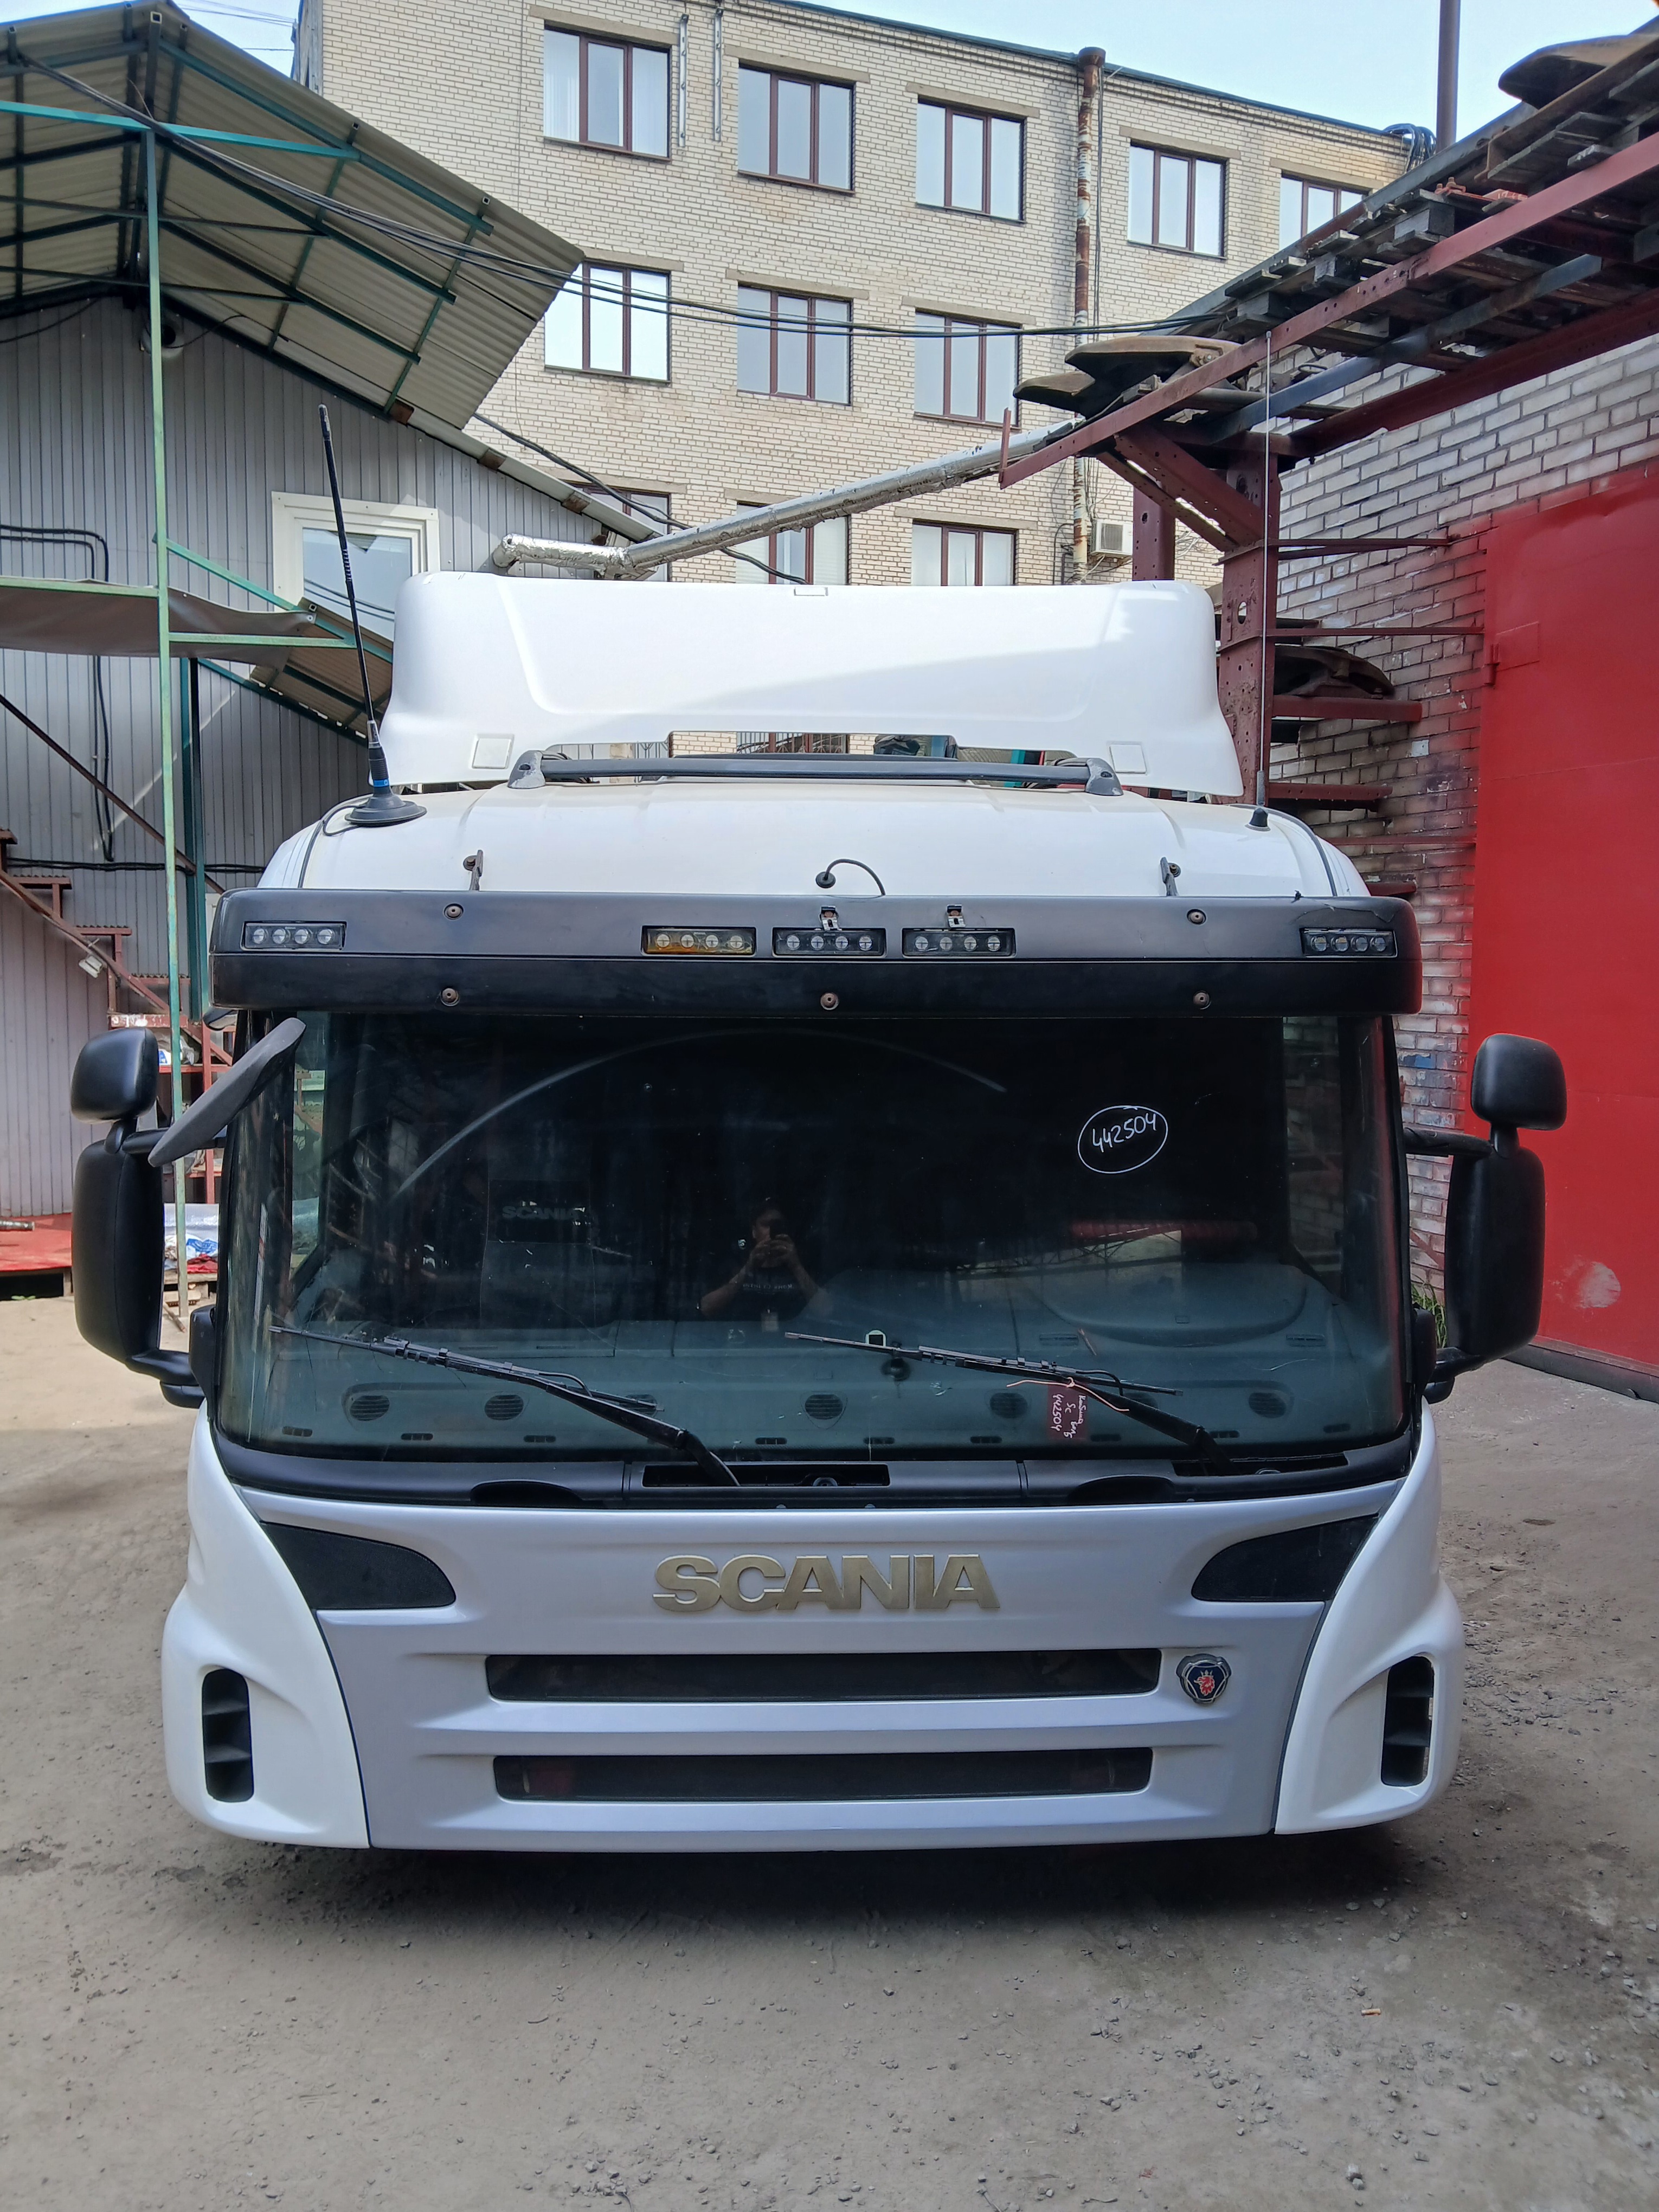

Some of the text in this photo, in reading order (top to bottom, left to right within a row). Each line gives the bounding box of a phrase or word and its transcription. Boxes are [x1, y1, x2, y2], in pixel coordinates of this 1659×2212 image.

[1092, 1113, 1157, 1153] 442504
[1050, 1394, 1065, 1431] 442504
[652, 1554, 1000, 1612] SCANIA
